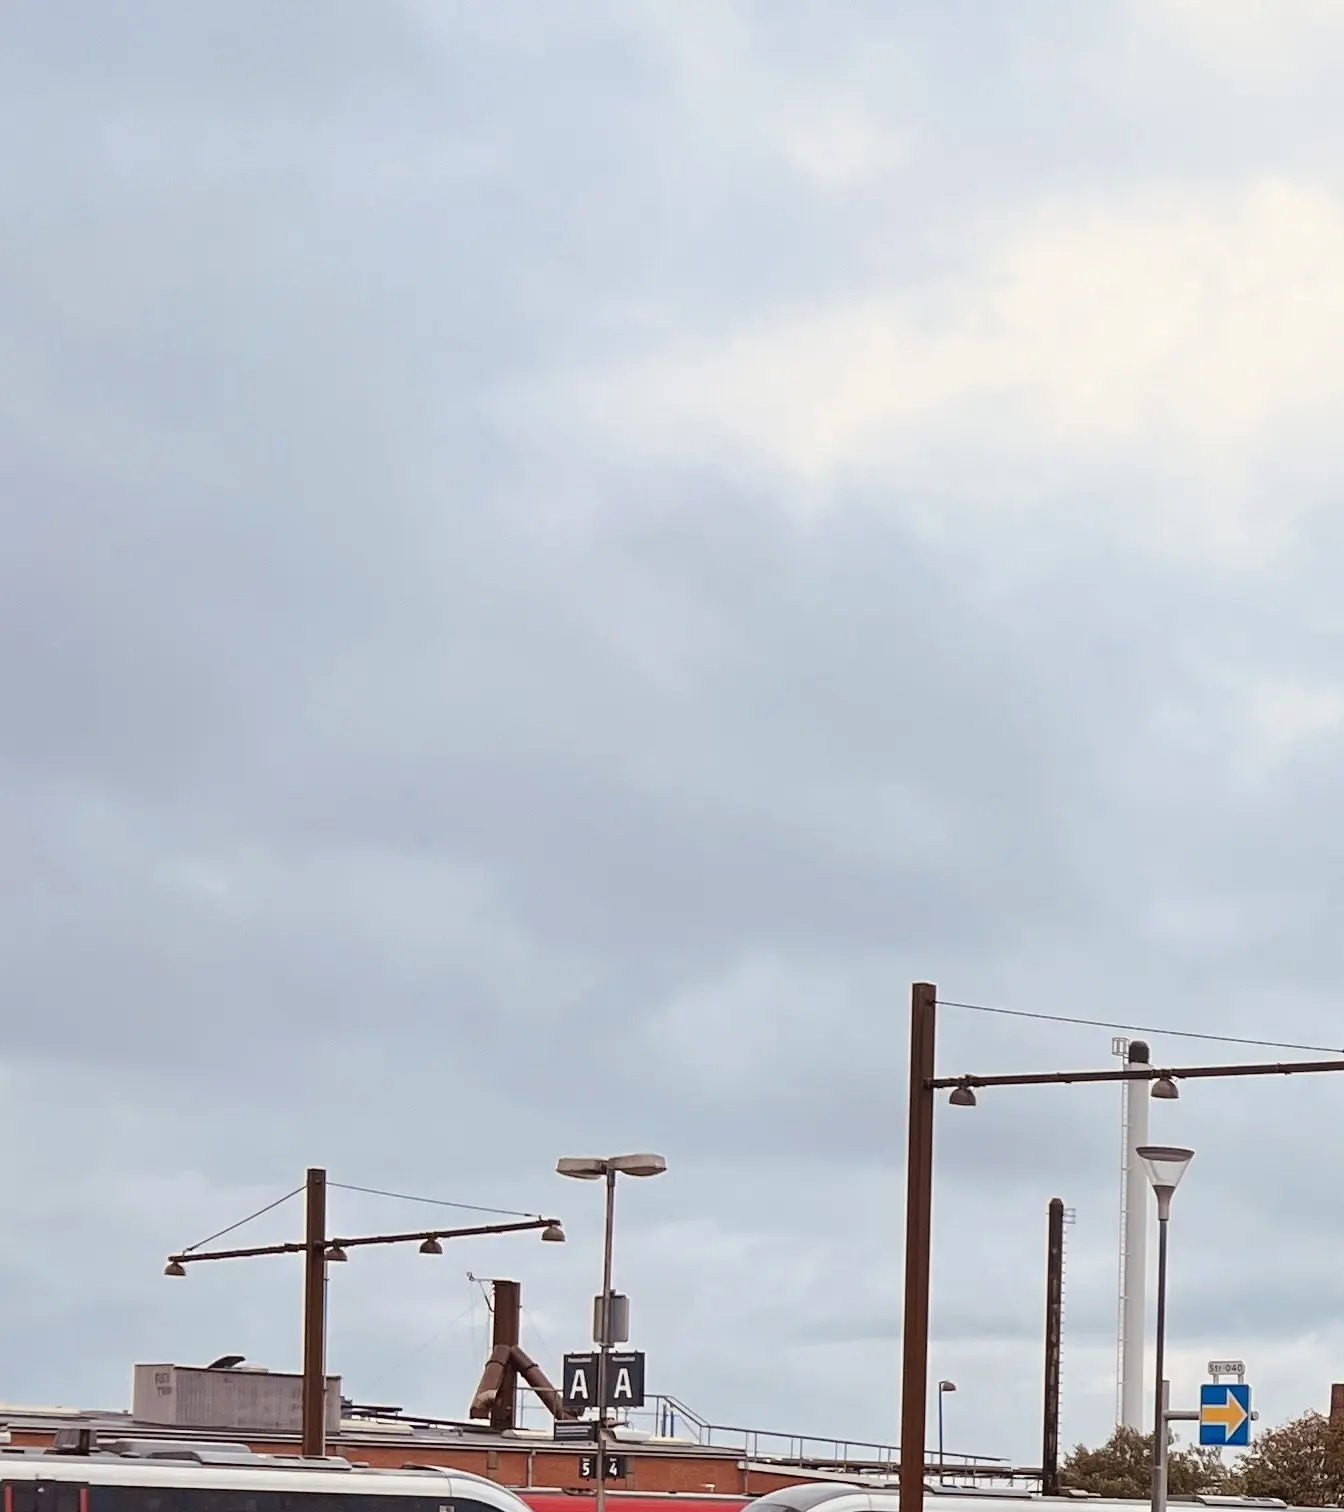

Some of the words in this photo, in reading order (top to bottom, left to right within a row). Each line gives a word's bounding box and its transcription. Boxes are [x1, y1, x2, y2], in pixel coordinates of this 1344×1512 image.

[569, 1369, 589, 1399] A
[613, 1368, 633, 1398] A
[582, 1462, 590, 1476] 5
[609, 1462, 618, 1476] 4
